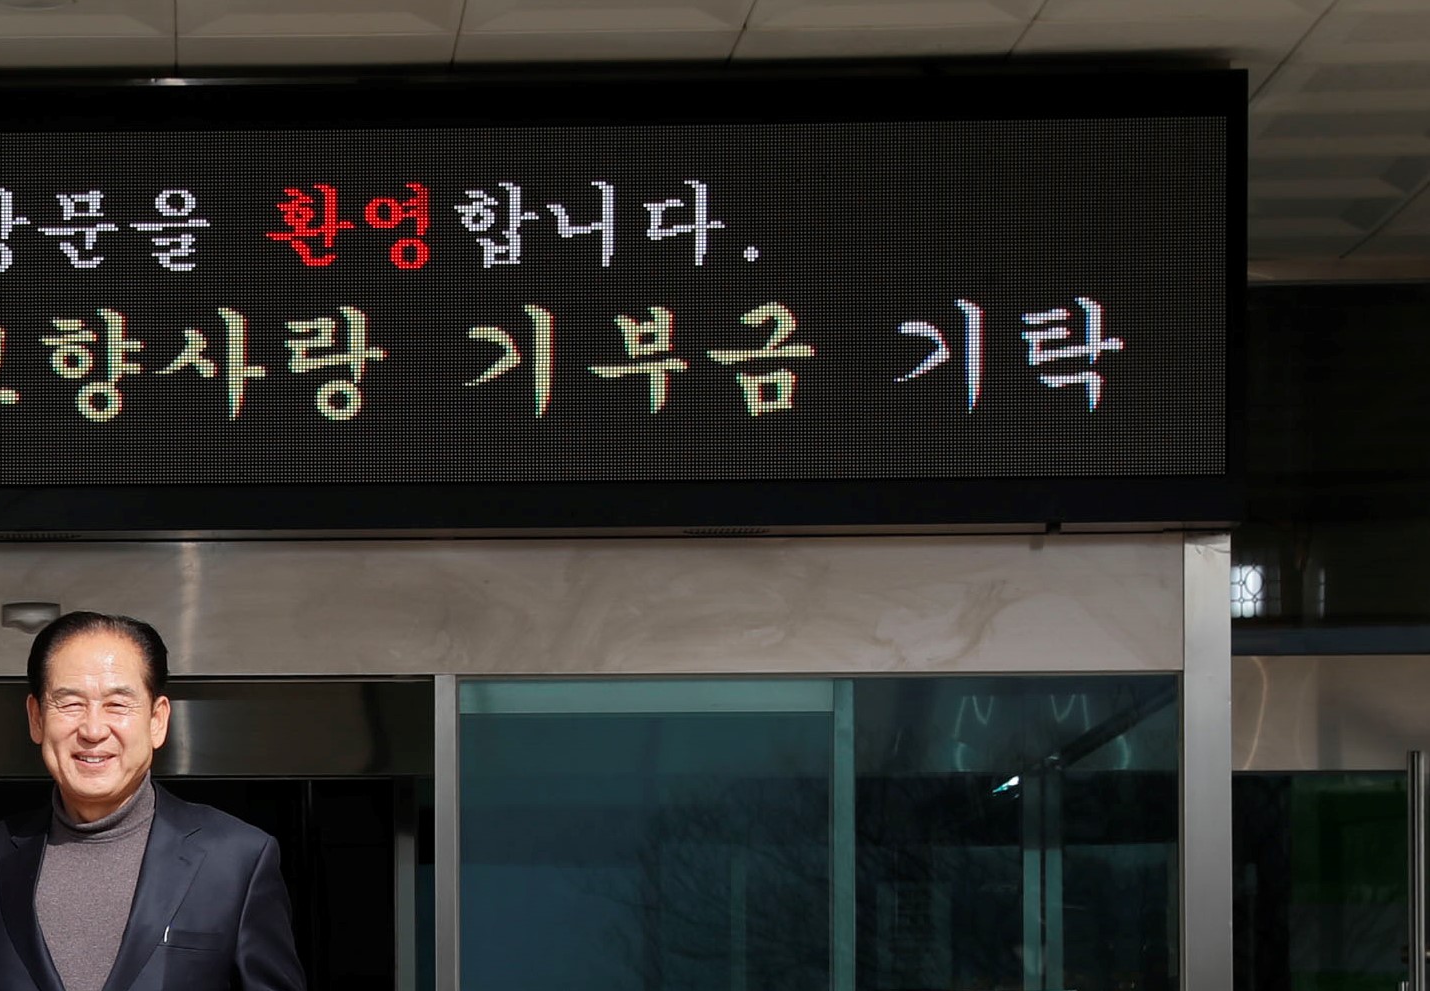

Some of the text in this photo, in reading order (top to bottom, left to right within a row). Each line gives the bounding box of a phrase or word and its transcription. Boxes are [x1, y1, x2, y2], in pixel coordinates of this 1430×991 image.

[265, 180, 759, 268] 환영합니다.
[464, 301, 815, 419] 기부금
[893, 297, 1124, 414] 기탁
